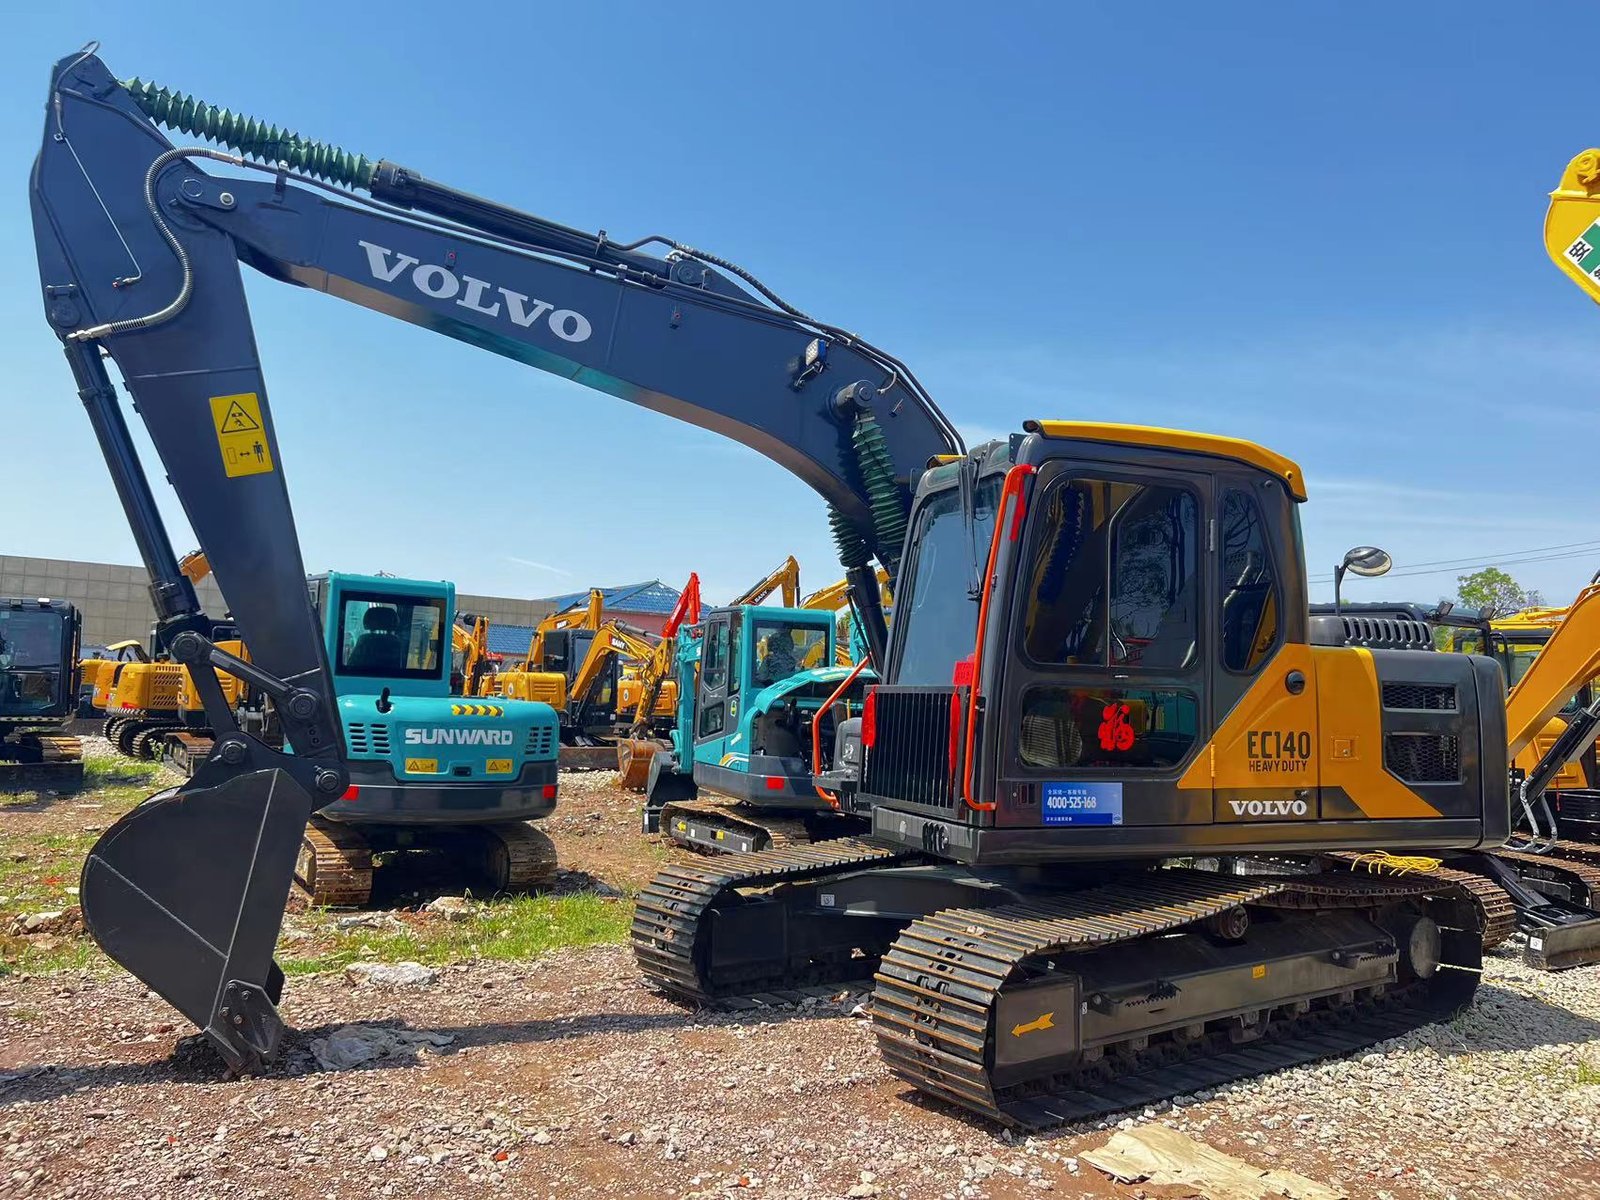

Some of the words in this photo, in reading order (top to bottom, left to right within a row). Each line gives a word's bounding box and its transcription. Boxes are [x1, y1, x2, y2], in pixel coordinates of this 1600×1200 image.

[358, 240, 592, 343] VOLVO
[611, 637, 625, 649] SANY
[1098, 703, 1134, 751] 福
[405, 728, 513, 745] SUNWARD
[1247, 731, 1311, 759] EC140
[1249, 760, 1280, 772] HEAVY
[1282, 760, 1308, 772] DUTY
[1047, 796, 1097, 809] 4000-525-168
[1228, 800, 1307, 815] VOLVO
